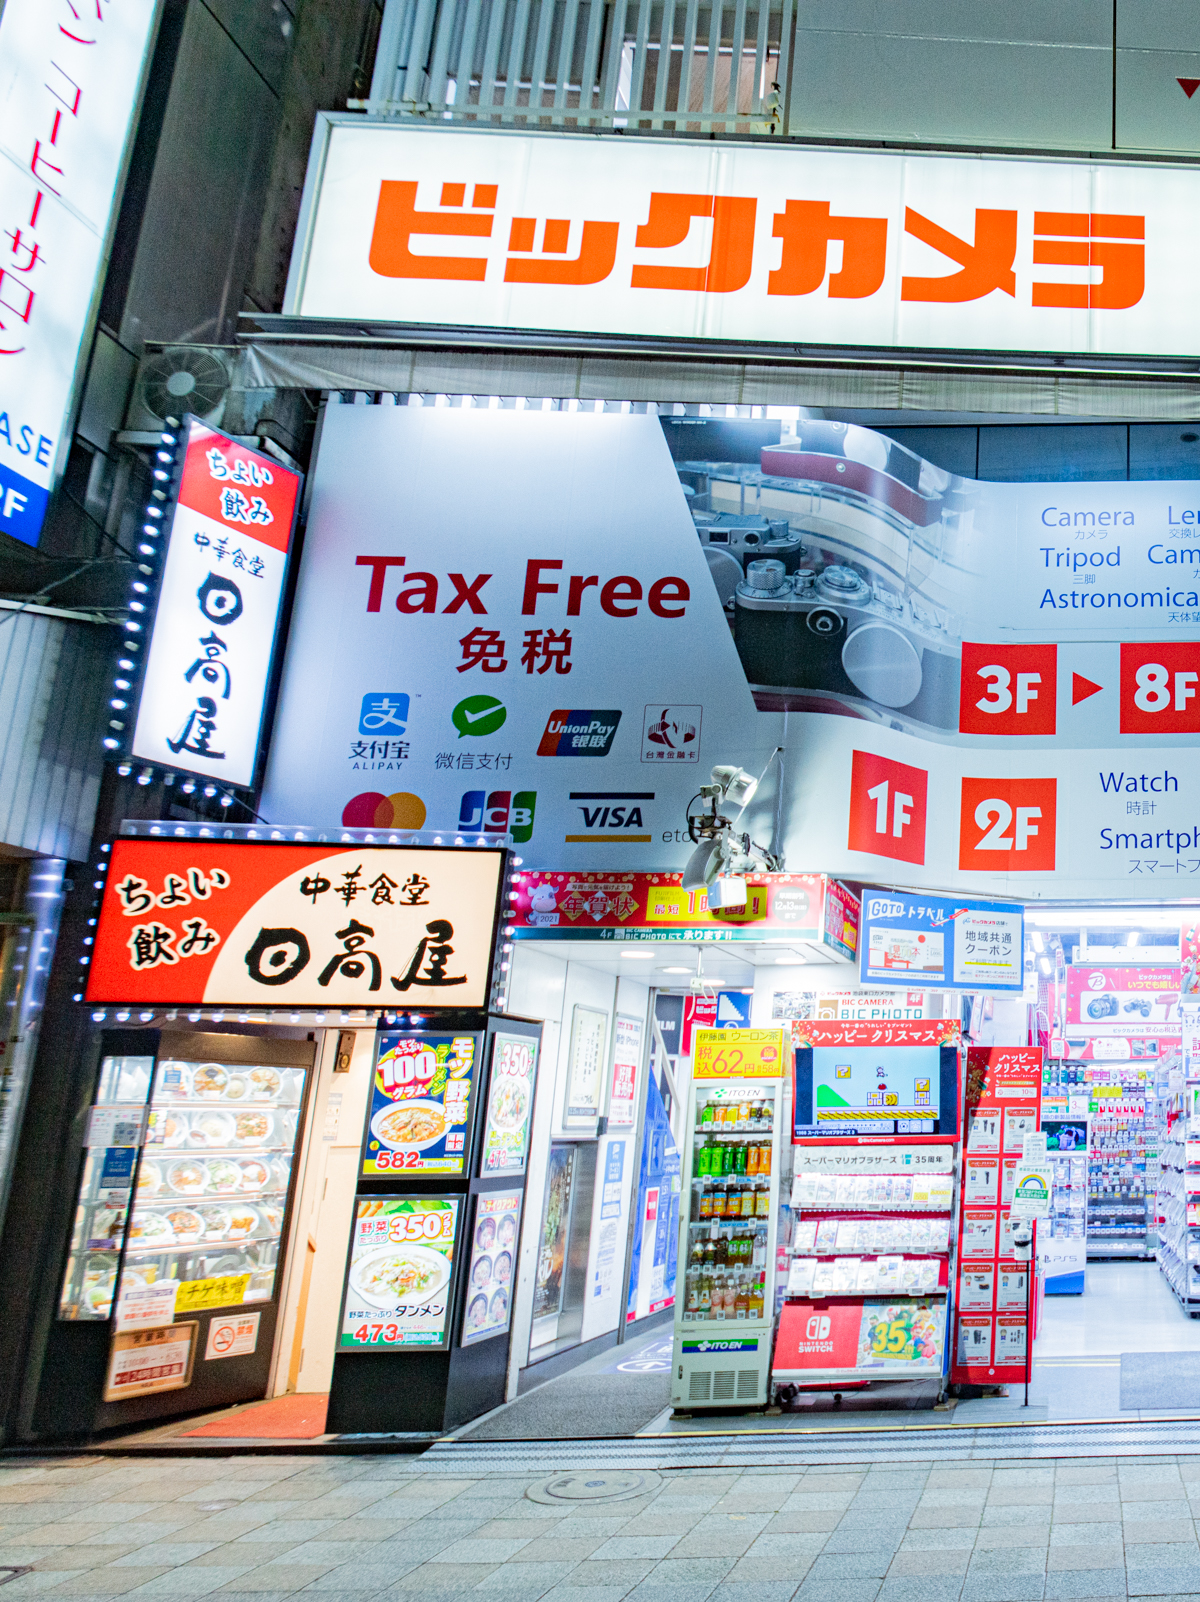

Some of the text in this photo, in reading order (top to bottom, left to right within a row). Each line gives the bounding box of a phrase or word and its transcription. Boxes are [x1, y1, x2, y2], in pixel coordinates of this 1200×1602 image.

[368, 179, 1146, 310] ビックカメラ
[206, 447, 274, 486] ちょい
[221, 491, 274, 525] 飲み
[1040, 506, 1136, 528] Camera
[1074, 529, 1108, 540] カメラ
[193, 531, 266, 579] 中華食堂
[1040, 546, 1121, 572] Tripod
[355, 555, 691, 619] Tax Free
[1072, 574, 1096, 585] 三脚
[455, 626, 574, 675] 免税
[166, 571, 244, 760] 日高屋
[974, 663, 1042, 715] 3F
[1133, 663, 1199, 713] 8F
[548, 719, 615, 737] UnionPay
[348, 740, 411, 760] 支付宝
[571, 735, 607, 749] 银联
[352, 762, 404, 771] ALIPAY
[434, 752, 513, 771] 微信支付
[1099, 770, 1179, 793] Watch
[458, 808, 533, 827] JCB
[578, 807, 644, 828] VISA
[867, 778, 913, 839] 1F
[1125, 800, 1158, 816] 時計
[973, 800, 1041, 852] 2F
[119, 867, 227, 914] ちょい
[299, 864, 431, 908] 中華食堂
[563, 895, 635, 916] 年賀状
[654, 904, 679, 915] 最短
[908, 906, 944, 920] トラベル
[133, 920, 217, 968] 飲み
[640, 932, 667, 940] PHOTO
[965, 930, 1013, 944] 地域共通
[244, 918, 468, 992] 日高屋
[965, 943, 1012, 957] クーポン
[841, 1008, 923, 1019] BIC PHOTO
[699, 1031, 779, 1041] 伊藤園 ウーロン茶
[818, 1029, 936, 1044] ハッピー クリスマス
[501, 1043, 528, 1076] 350
[998, 1052, 1036, 1063] ハッピー
[378, 1051, 437, 1087] 100
[432, 1045, 450, 1095] ラーメン
[993, 1063, 1041, 1073] クリスマス
[443, 1038, 474, 1124] モツ野菜
[392, 1084, 428, 1100] グラム
[376, 1151, 425, 1169] 582円
[804, 1155, 943, 1165] スーパーマリオブラザーズ 35周年
[360, 1220, 388, 1234] 野菜
[389, 1214, 442, 1241] 350
[359, 1235, 387, 1244] たっぷり
[348, 1305, 445, 1319] 野菜たっぷり タンメン
[354, 1323, 404, 1342] 473円
[798, 1345, 834, 1353] SWITCH
